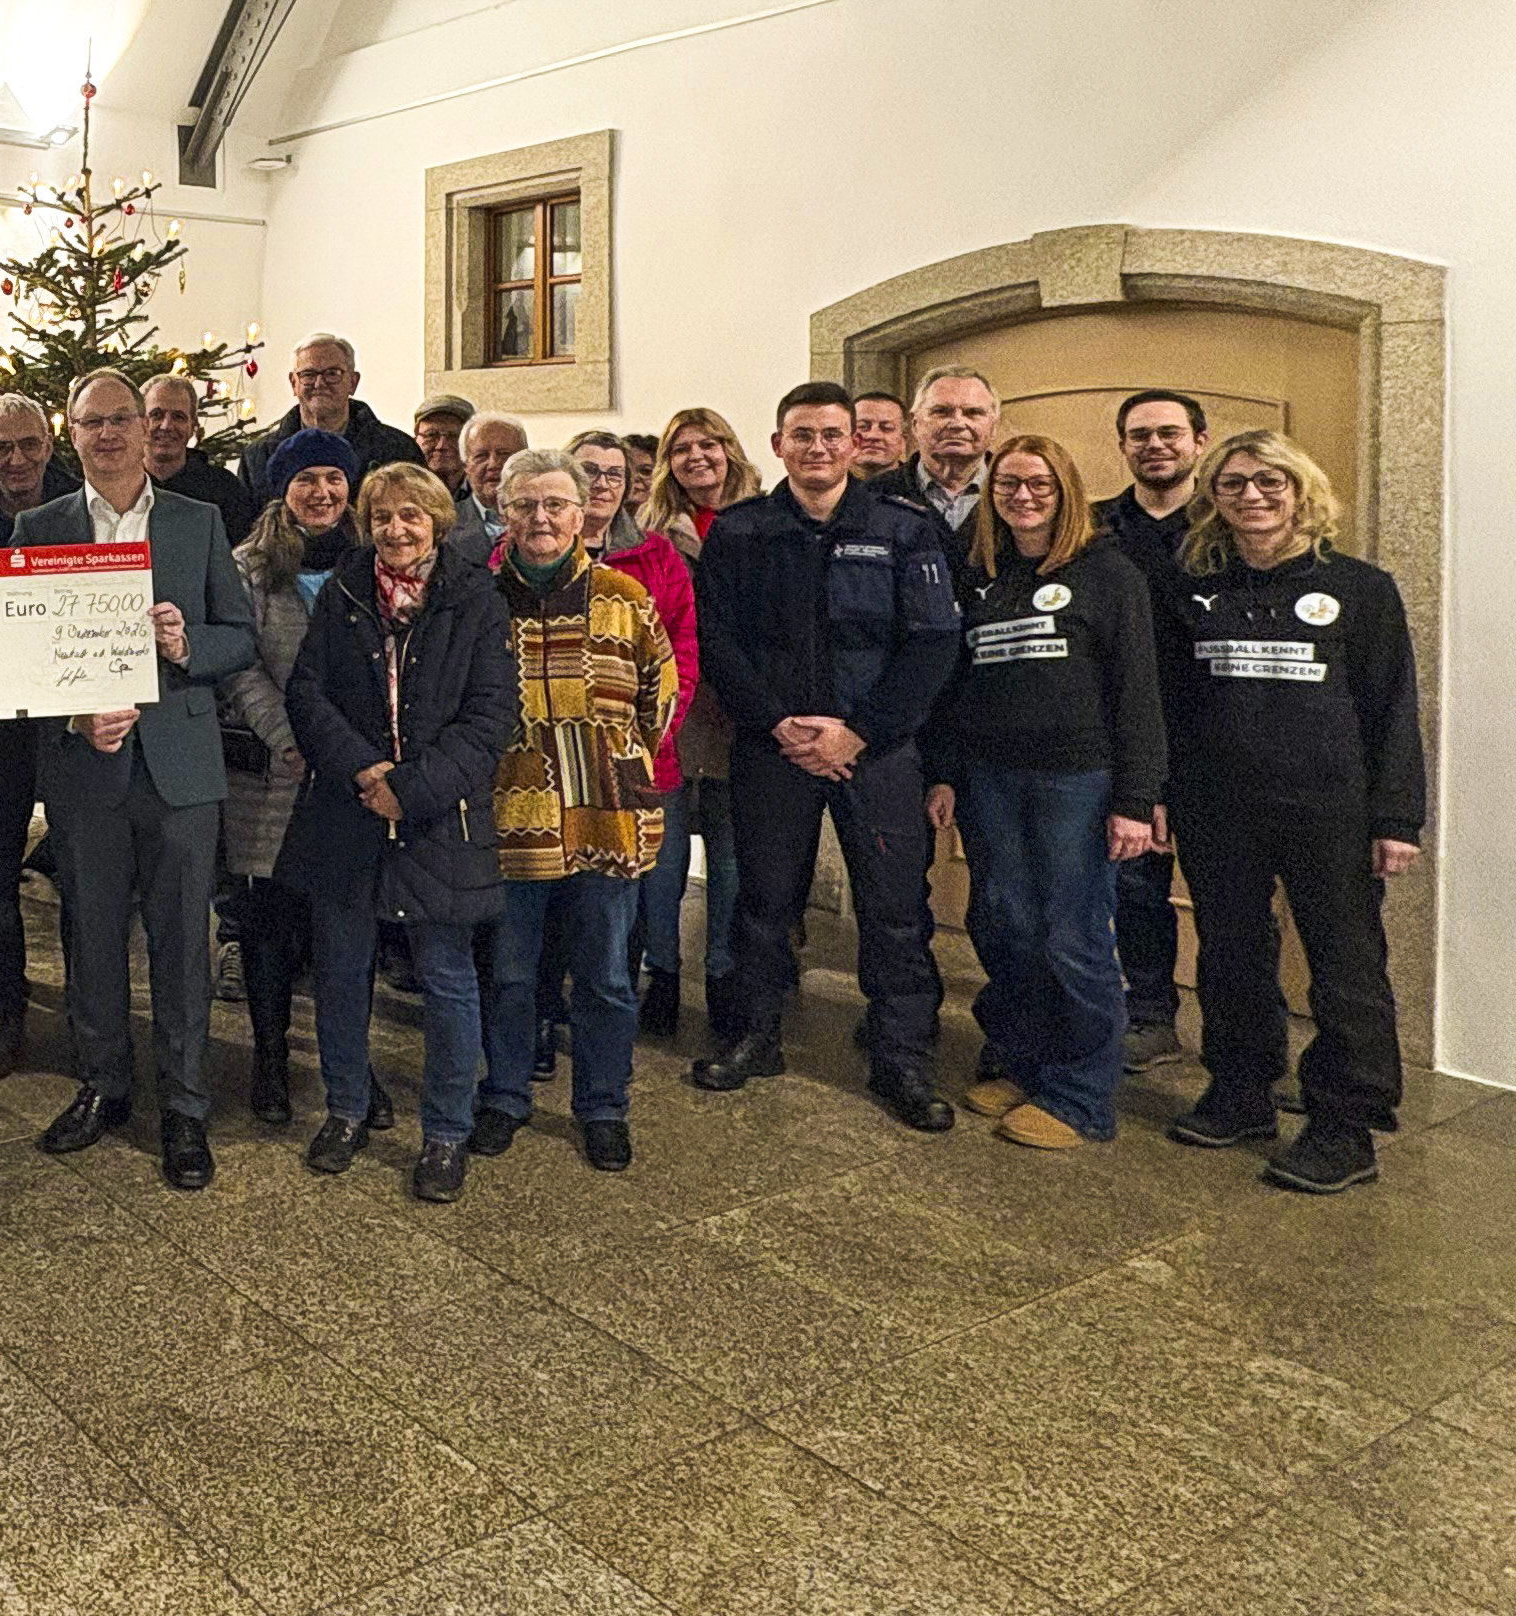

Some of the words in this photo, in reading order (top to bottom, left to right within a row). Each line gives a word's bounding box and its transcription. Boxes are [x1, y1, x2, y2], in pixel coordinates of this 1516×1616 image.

[31, 556, 84, 568] Vereinigte
[85, 552, 145, 566] Sparkassen
[921, 563, 941, 584] 11
[5, 600, 47, 618] Euro
[1261, 645, 1308, 656] KENNT
[1214, 662, 1250, 673] KEINE
